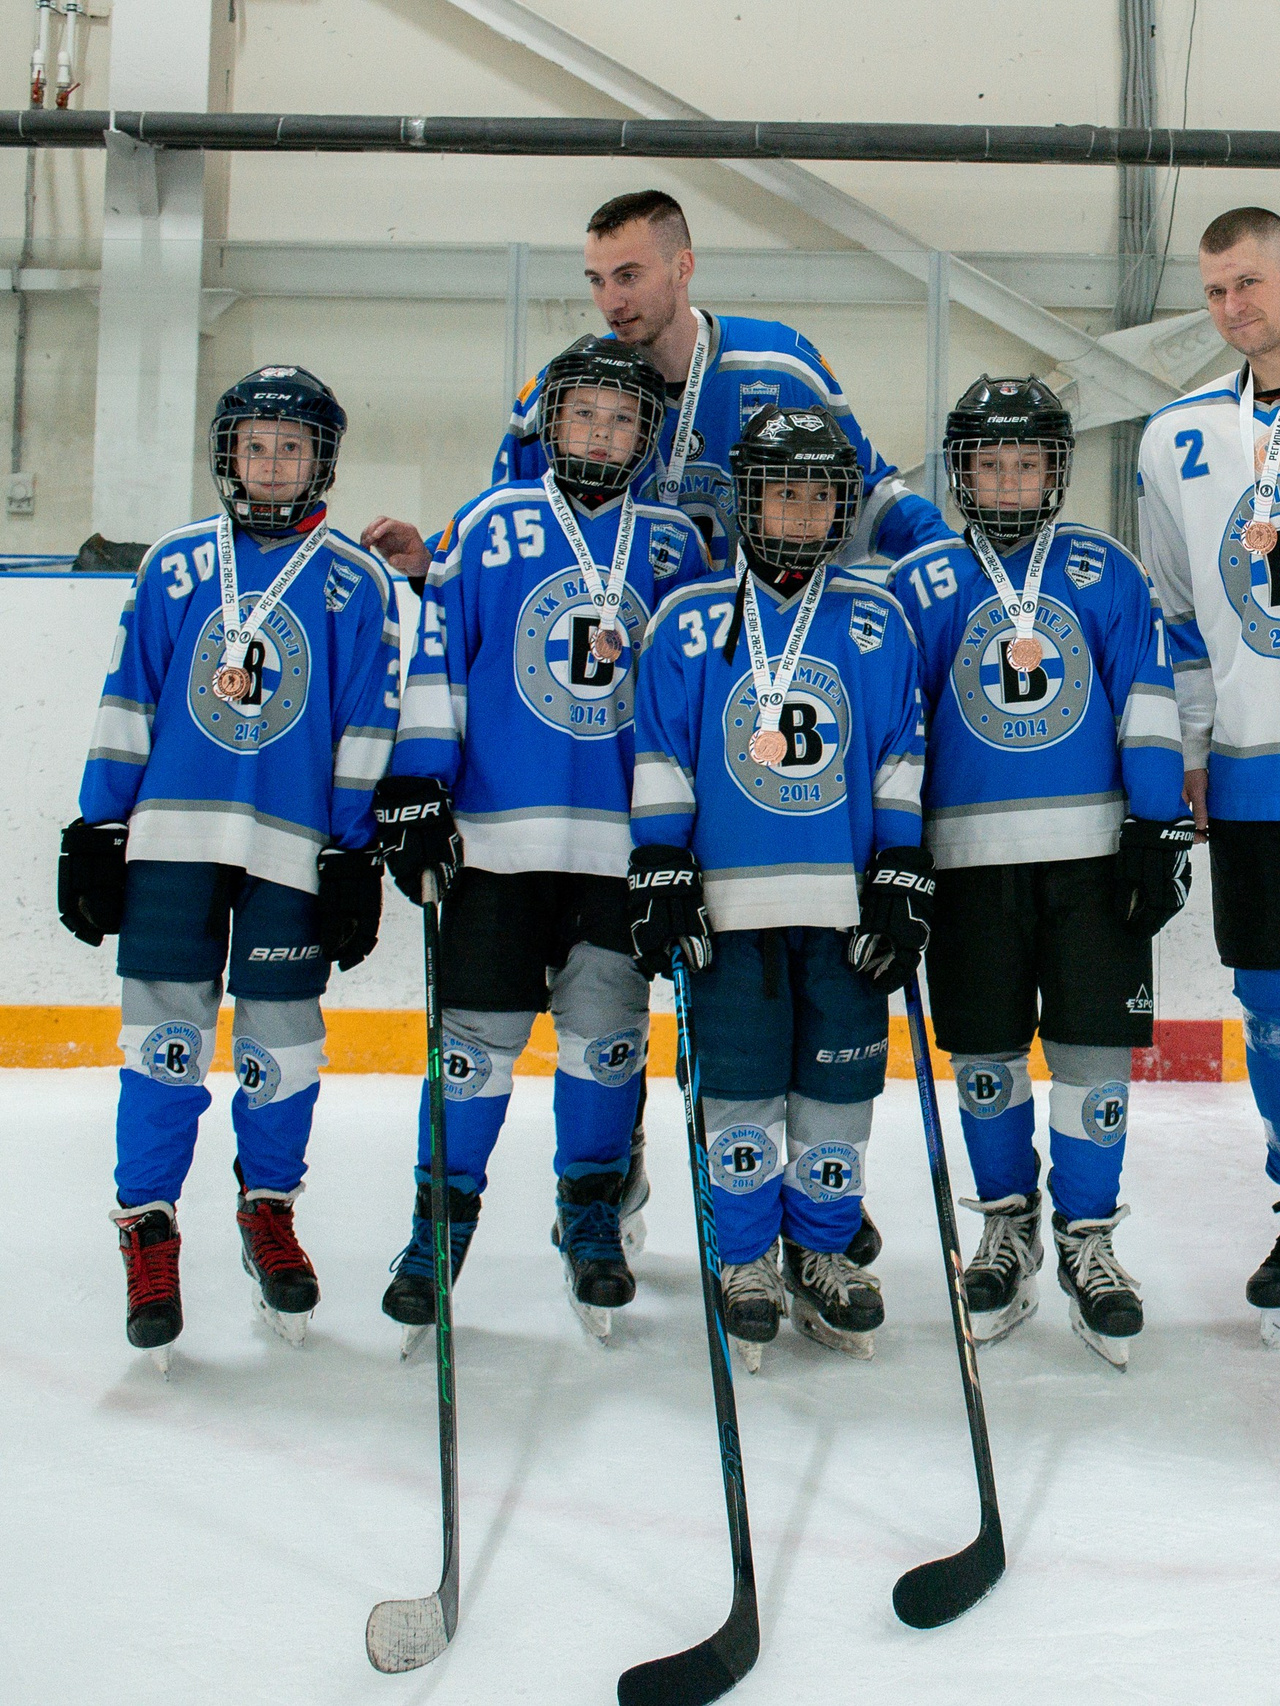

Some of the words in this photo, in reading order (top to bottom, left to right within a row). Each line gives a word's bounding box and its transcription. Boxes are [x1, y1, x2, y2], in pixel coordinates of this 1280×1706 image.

[674, 390, 695, 457] РЕГИОНАЛЬНЫЙ
[689, 341, 705, 389] ЧЕМПИОНАТ
[794, 453, 836, 461] BAUER
[1175, 428, 1210, 481] 2
[560, 512, 577, 537] СЕЗОН
[222, 541, 231, 564] СЕЗОН
[482, 510, 545, 569] 35
[259, 550, 308, 611] РЕГИОНАЛЬНЫЙ
[985, 554, 1005, 584] 2024/25
[909, 557, 959, 609] 15
[534, 591, 561, 623] ХК
[746, 607, 758, 632] СЕЗОН
[782, 605, 812, 671] РЕГИОНАЛЬНЫЙ
[805, 568, 824, 606] ЧЕМПИОНА
[964, 611, 989, 650] ХК
[751, 633, 764, 669] 2024/25
[569, 704, 607, 726] 2014
[1003, 719, 1049, 740] 2014
[779, 783, 822, 803] 2014
[374, 801, 441, 823] AUER
[627, 870, 694, 892] AUER
[872, 869, 936, 897] BAUE
[248, 945, 321, 961] BAUE
[732, 1178, 754, 1188] 2014
